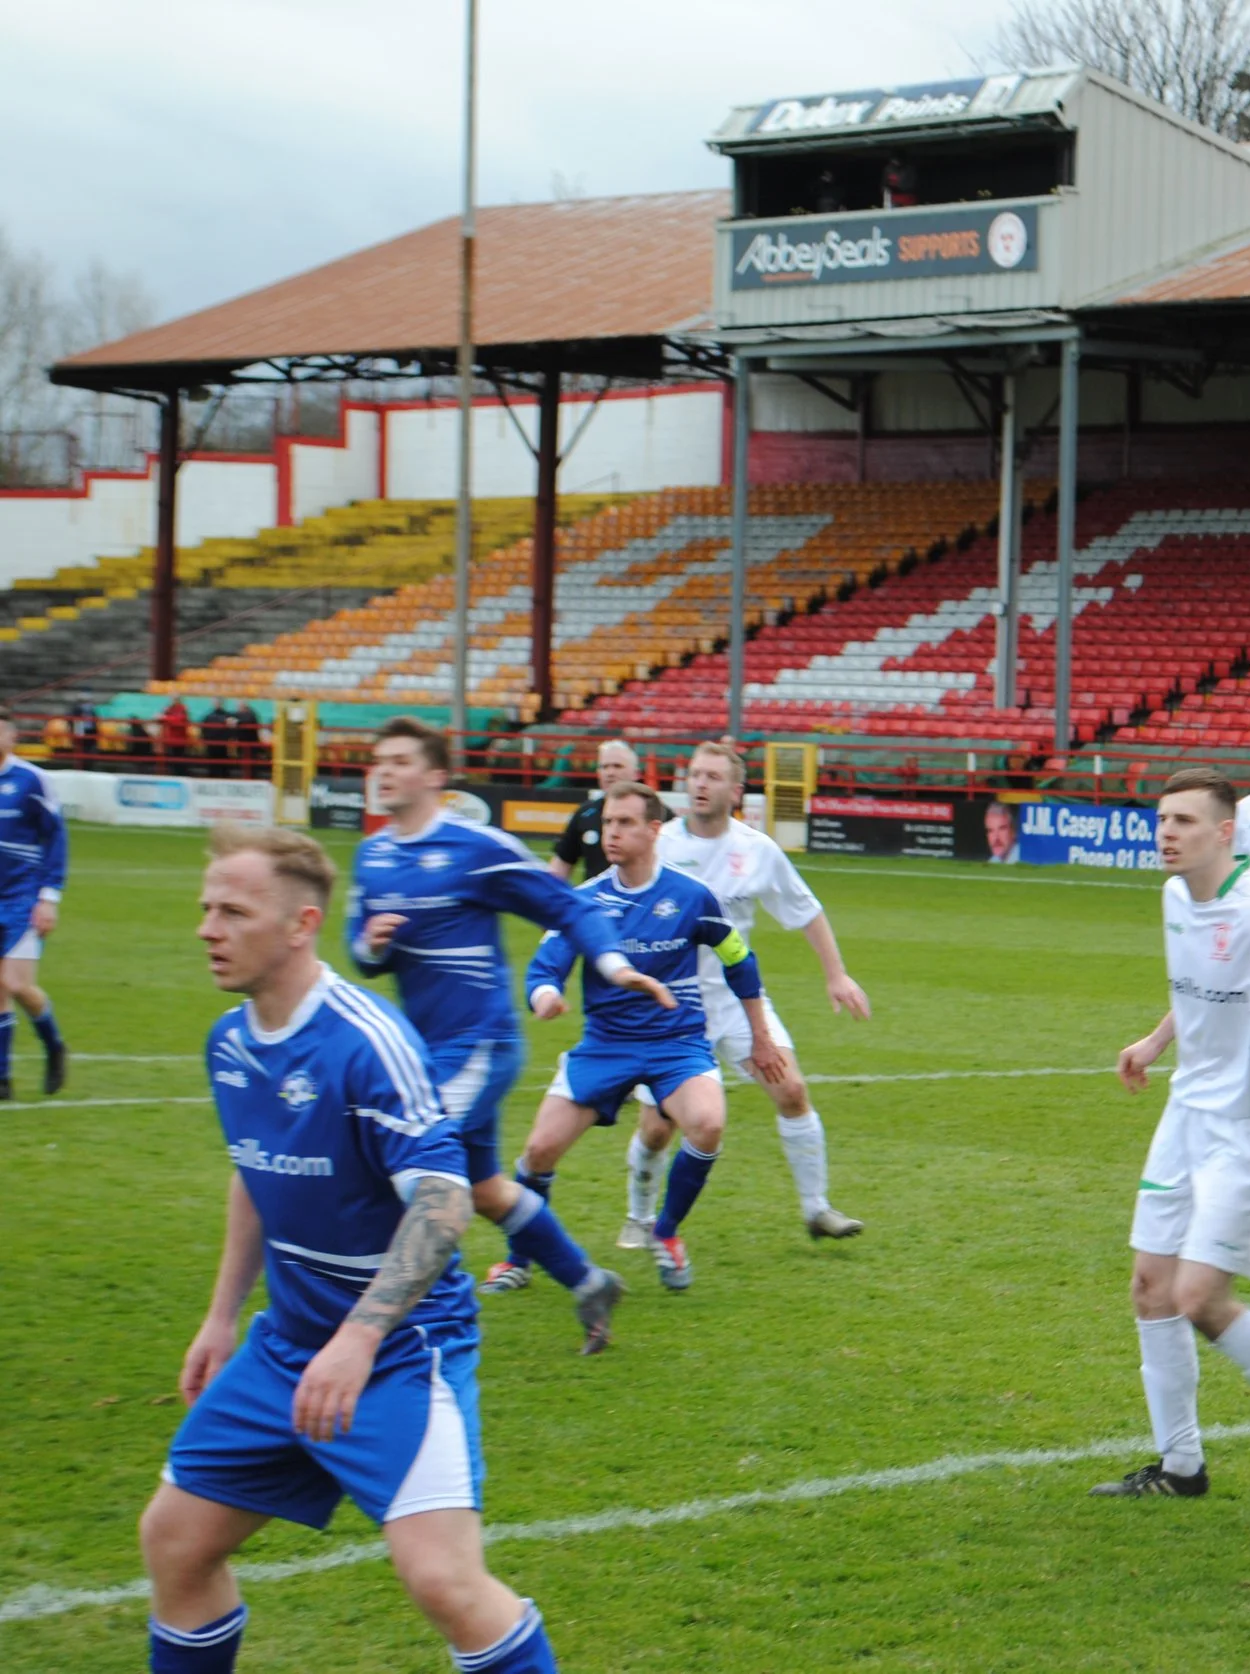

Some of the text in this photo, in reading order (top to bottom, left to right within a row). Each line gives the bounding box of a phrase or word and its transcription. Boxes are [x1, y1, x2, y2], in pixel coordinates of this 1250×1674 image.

[897, 230, 980, 262] SUPPORTS
[1022, 806, 1153, 846] J.M. Casey & Co.
[1069, 845, 1114, 867] Phone
[1117, 849, 1134, 868] 01
